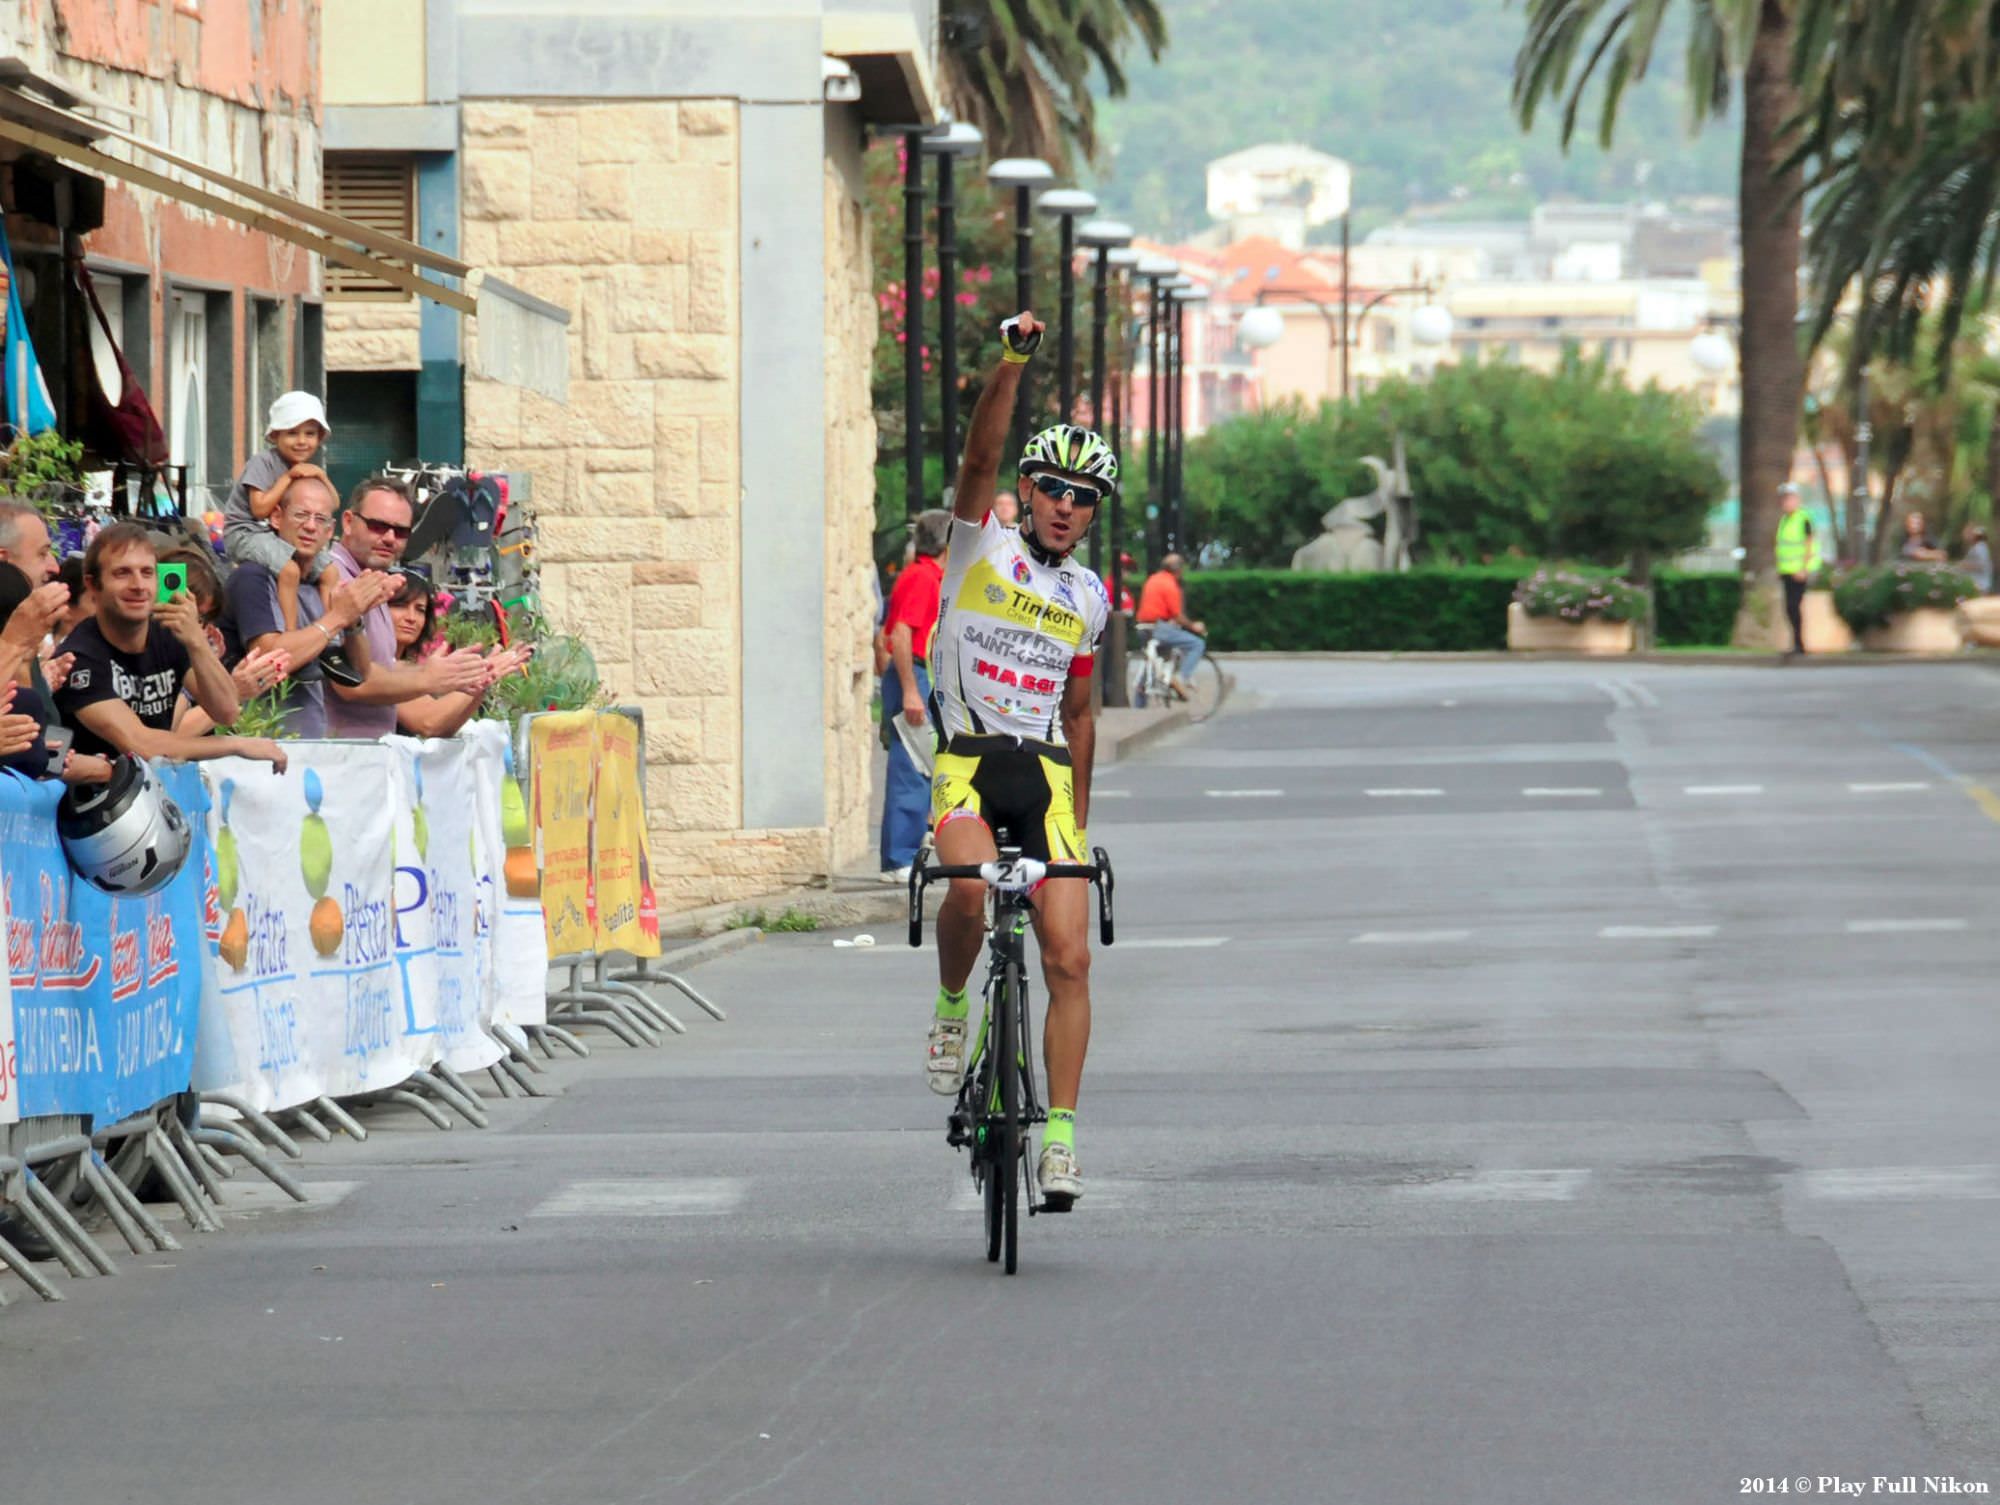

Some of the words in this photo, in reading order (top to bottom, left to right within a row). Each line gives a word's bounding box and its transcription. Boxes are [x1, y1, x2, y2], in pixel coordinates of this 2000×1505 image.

[1012, 590, 1075, 628] Tinkoff
[997, 862, 1028, 884] 21
[343, 882, 388, 966] Pietra
